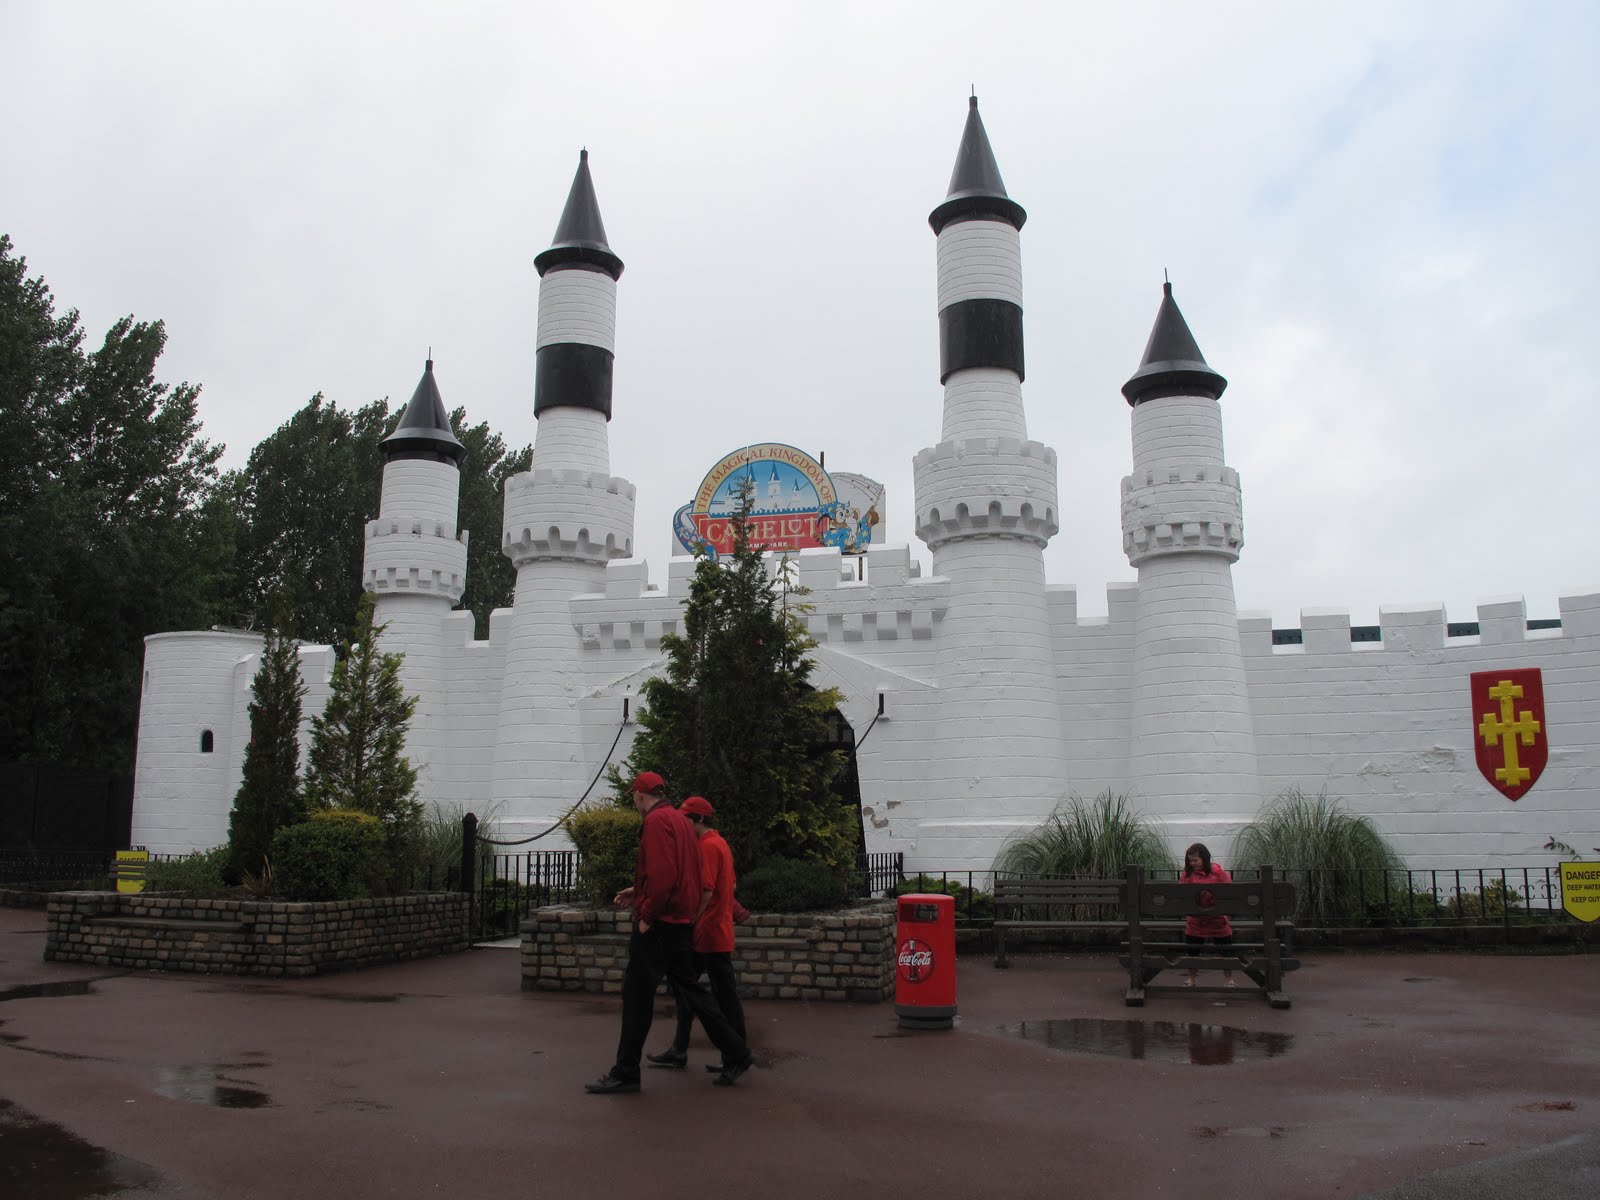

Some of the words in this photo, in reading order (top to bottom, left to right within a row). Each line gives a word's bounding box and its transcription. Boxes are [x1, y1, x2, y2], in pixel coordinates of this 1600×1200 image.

[697, 482, 715, 510] THE
[713, 448, 766, 484] MAGICAL
[769, 447, 826, 485] KINGDOM
[820, 482, 833, 504] OF
[898, 951, 932, 966] Coca-Cola
